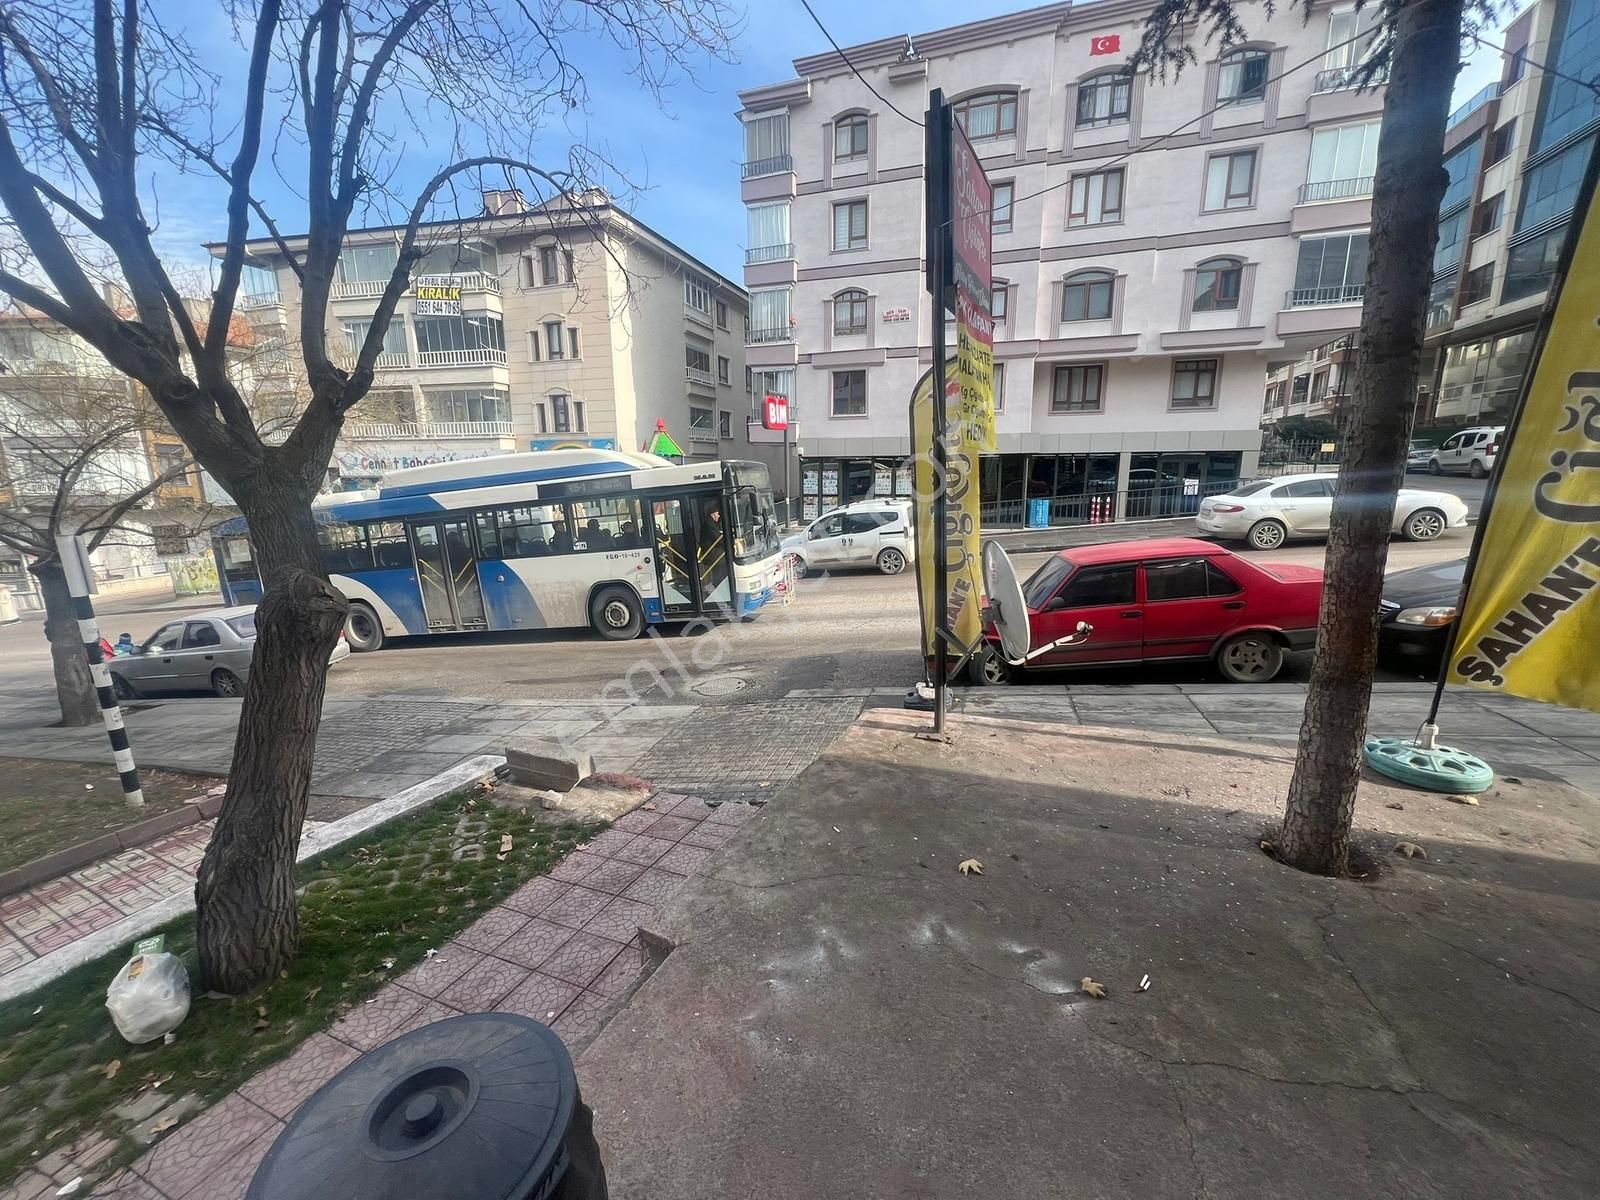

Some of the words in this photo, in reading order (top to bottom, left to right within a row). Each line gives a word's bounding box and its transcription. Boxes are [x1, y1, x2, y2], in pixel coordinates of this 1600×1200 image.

[417, 287, 460, 299] KİRALIK
[418, 301, 431, 314] 0551
[432, 301, 443, 314] 644
